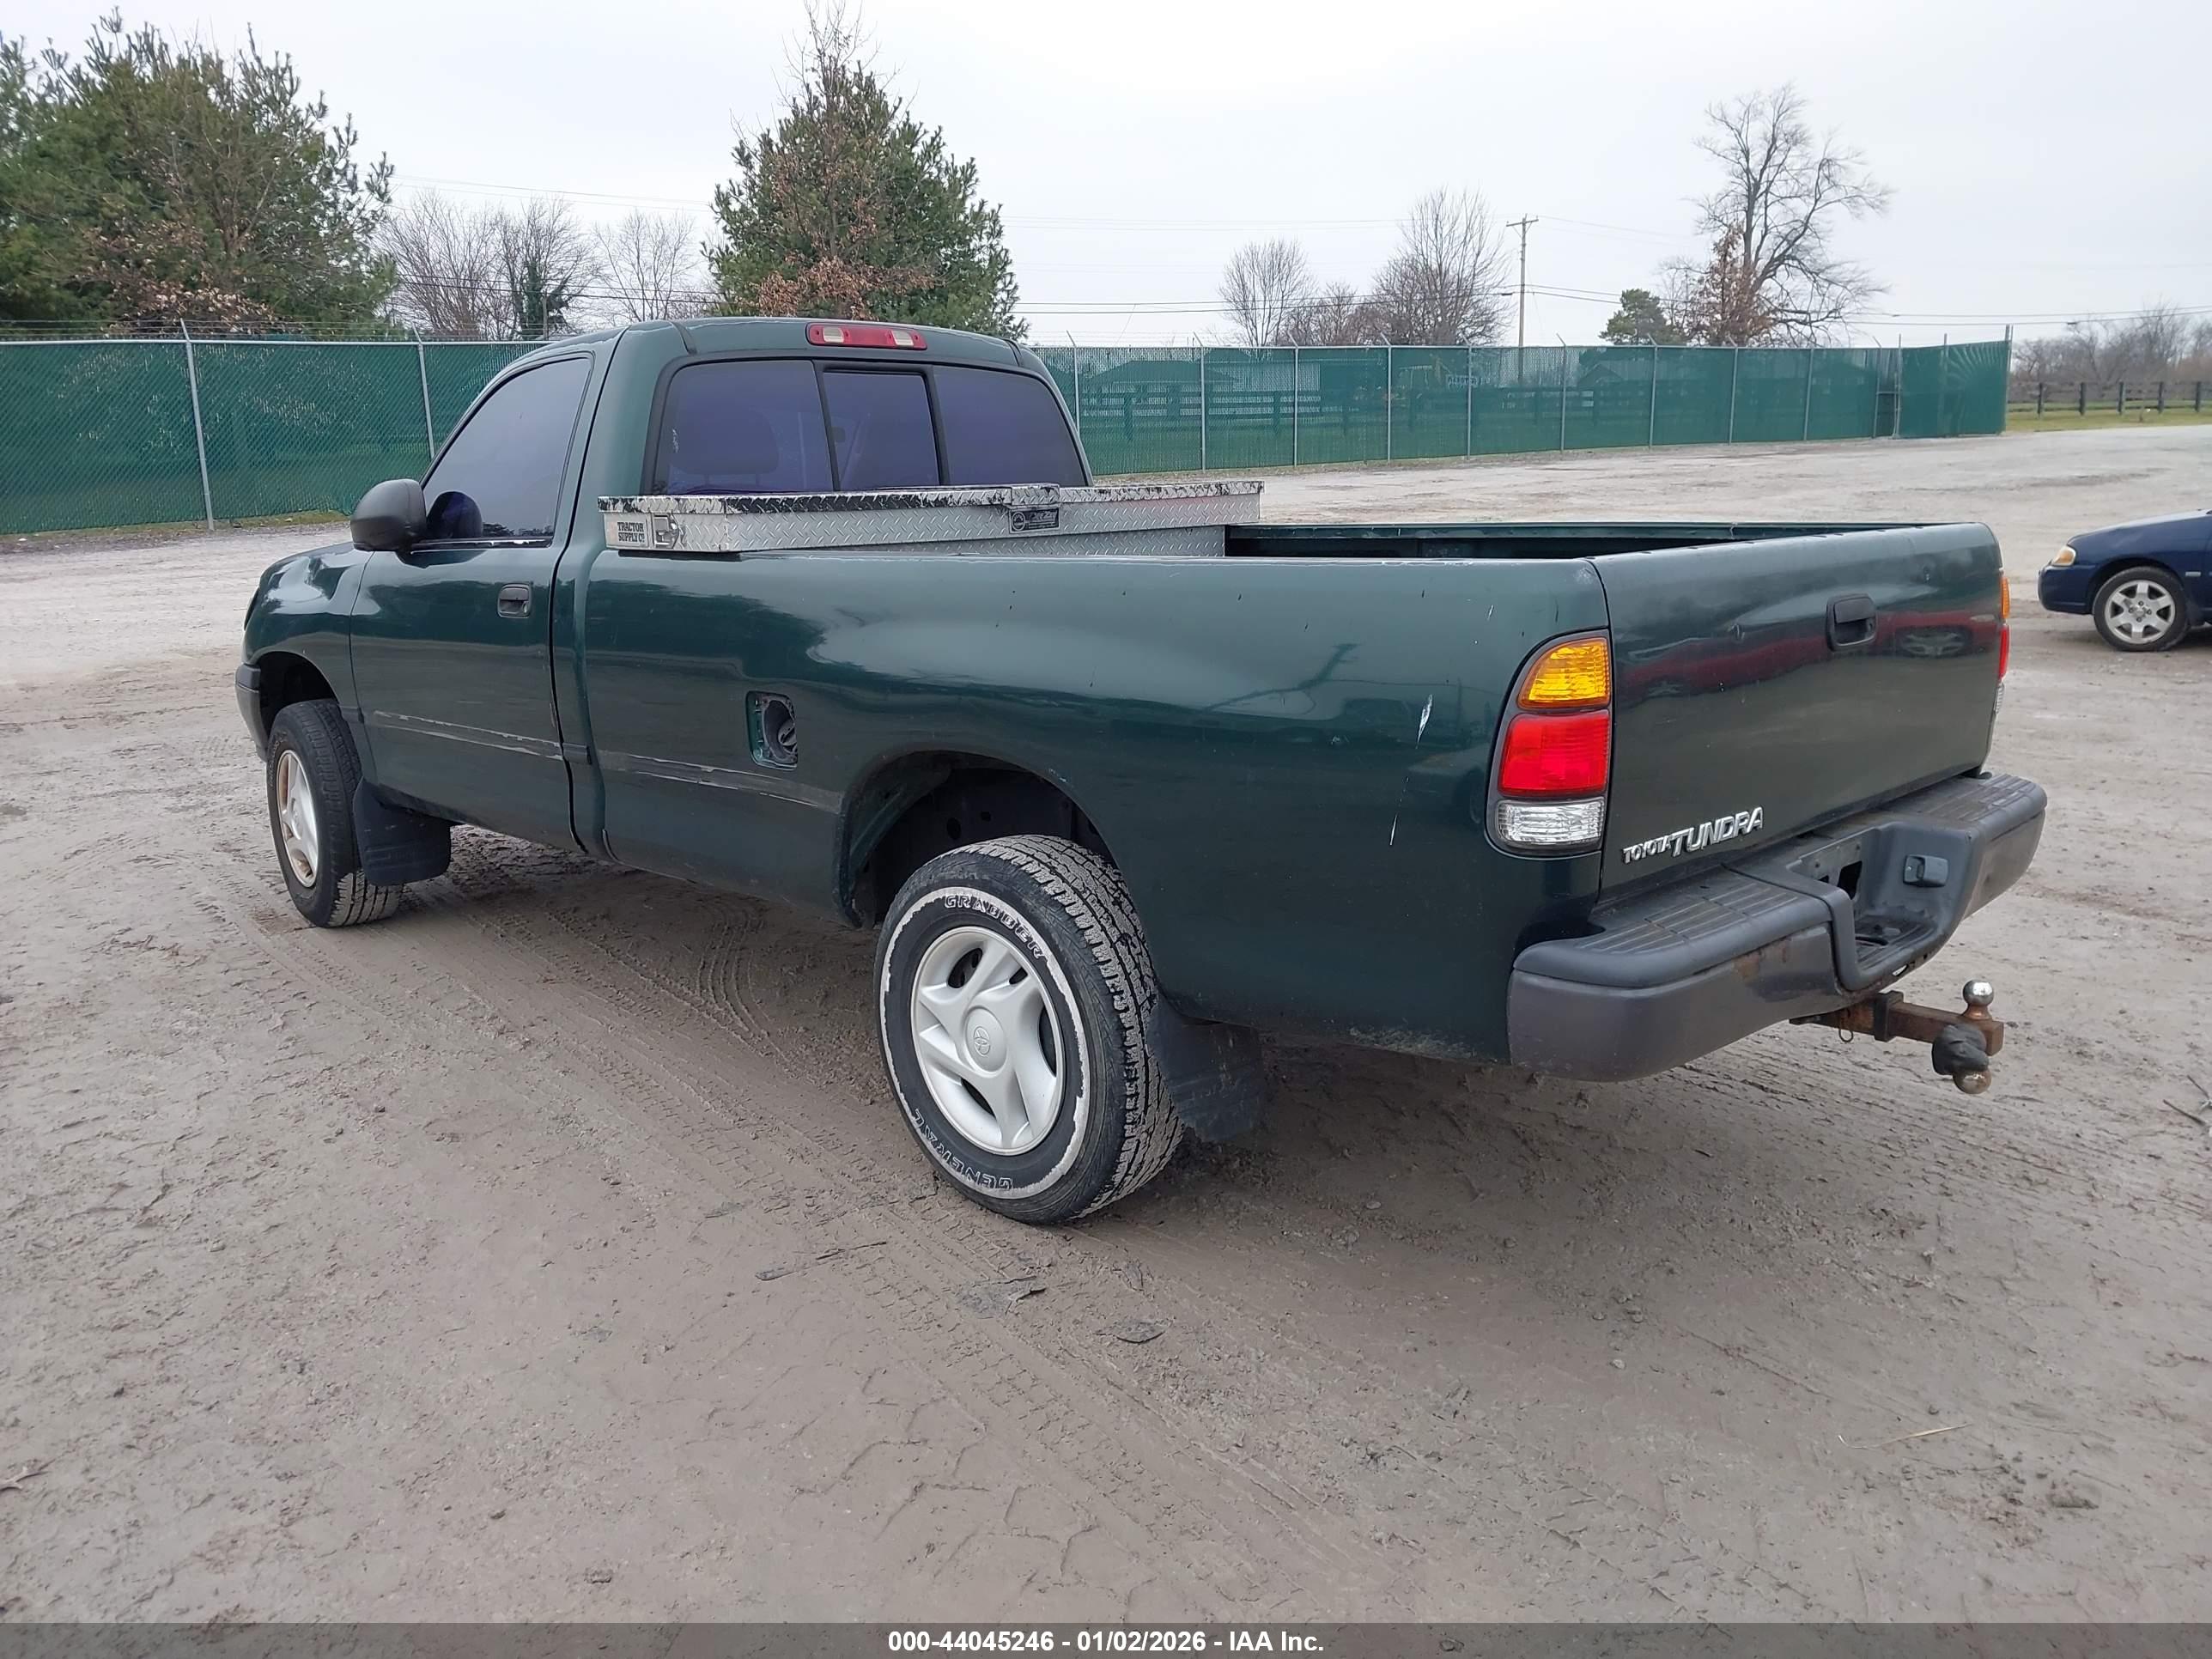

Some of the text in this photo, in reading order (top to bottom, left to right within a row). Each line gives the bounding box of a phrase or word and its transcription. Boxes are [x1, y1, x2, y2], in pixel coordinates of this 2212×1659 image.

[617, 521, 644, 532] TRACTOR
[618, 532, 638, 543] SUPPLY
[1622, 806, 1764, 864] TOYOTA TUNDRA
[945, 894, 1045, 959] GRABBER
[914, 1108, 1013, 1190] GENERAL
